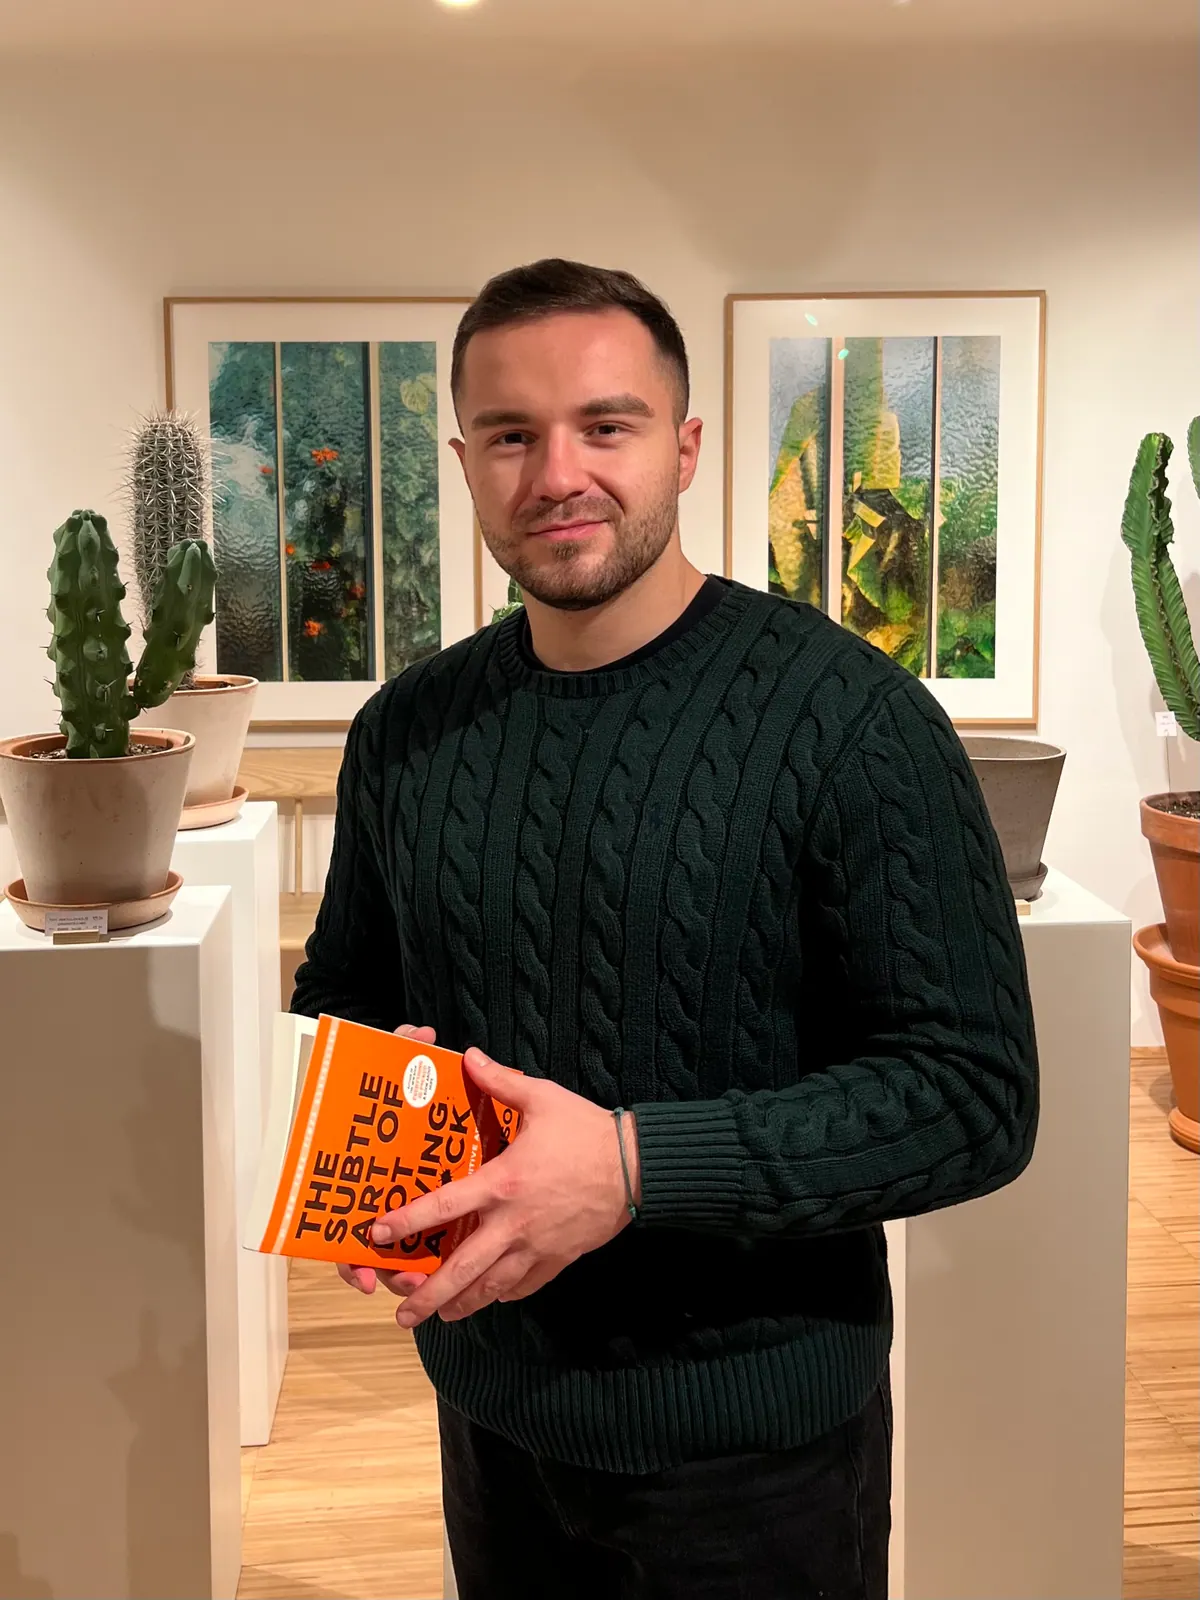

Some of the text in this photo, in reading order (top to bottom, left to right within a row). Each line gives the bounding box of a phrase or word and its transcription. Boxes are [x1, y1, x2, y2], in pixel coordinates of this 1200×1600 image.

[295, 1151, 340, 1239] THE
[324, 1072, 383, 1244] SUBTLE
[351, 1080, 403, 1248] ART OF
[372, 1157, 413, 1250] OT
[400, 1102, 448, 1253] GVING
